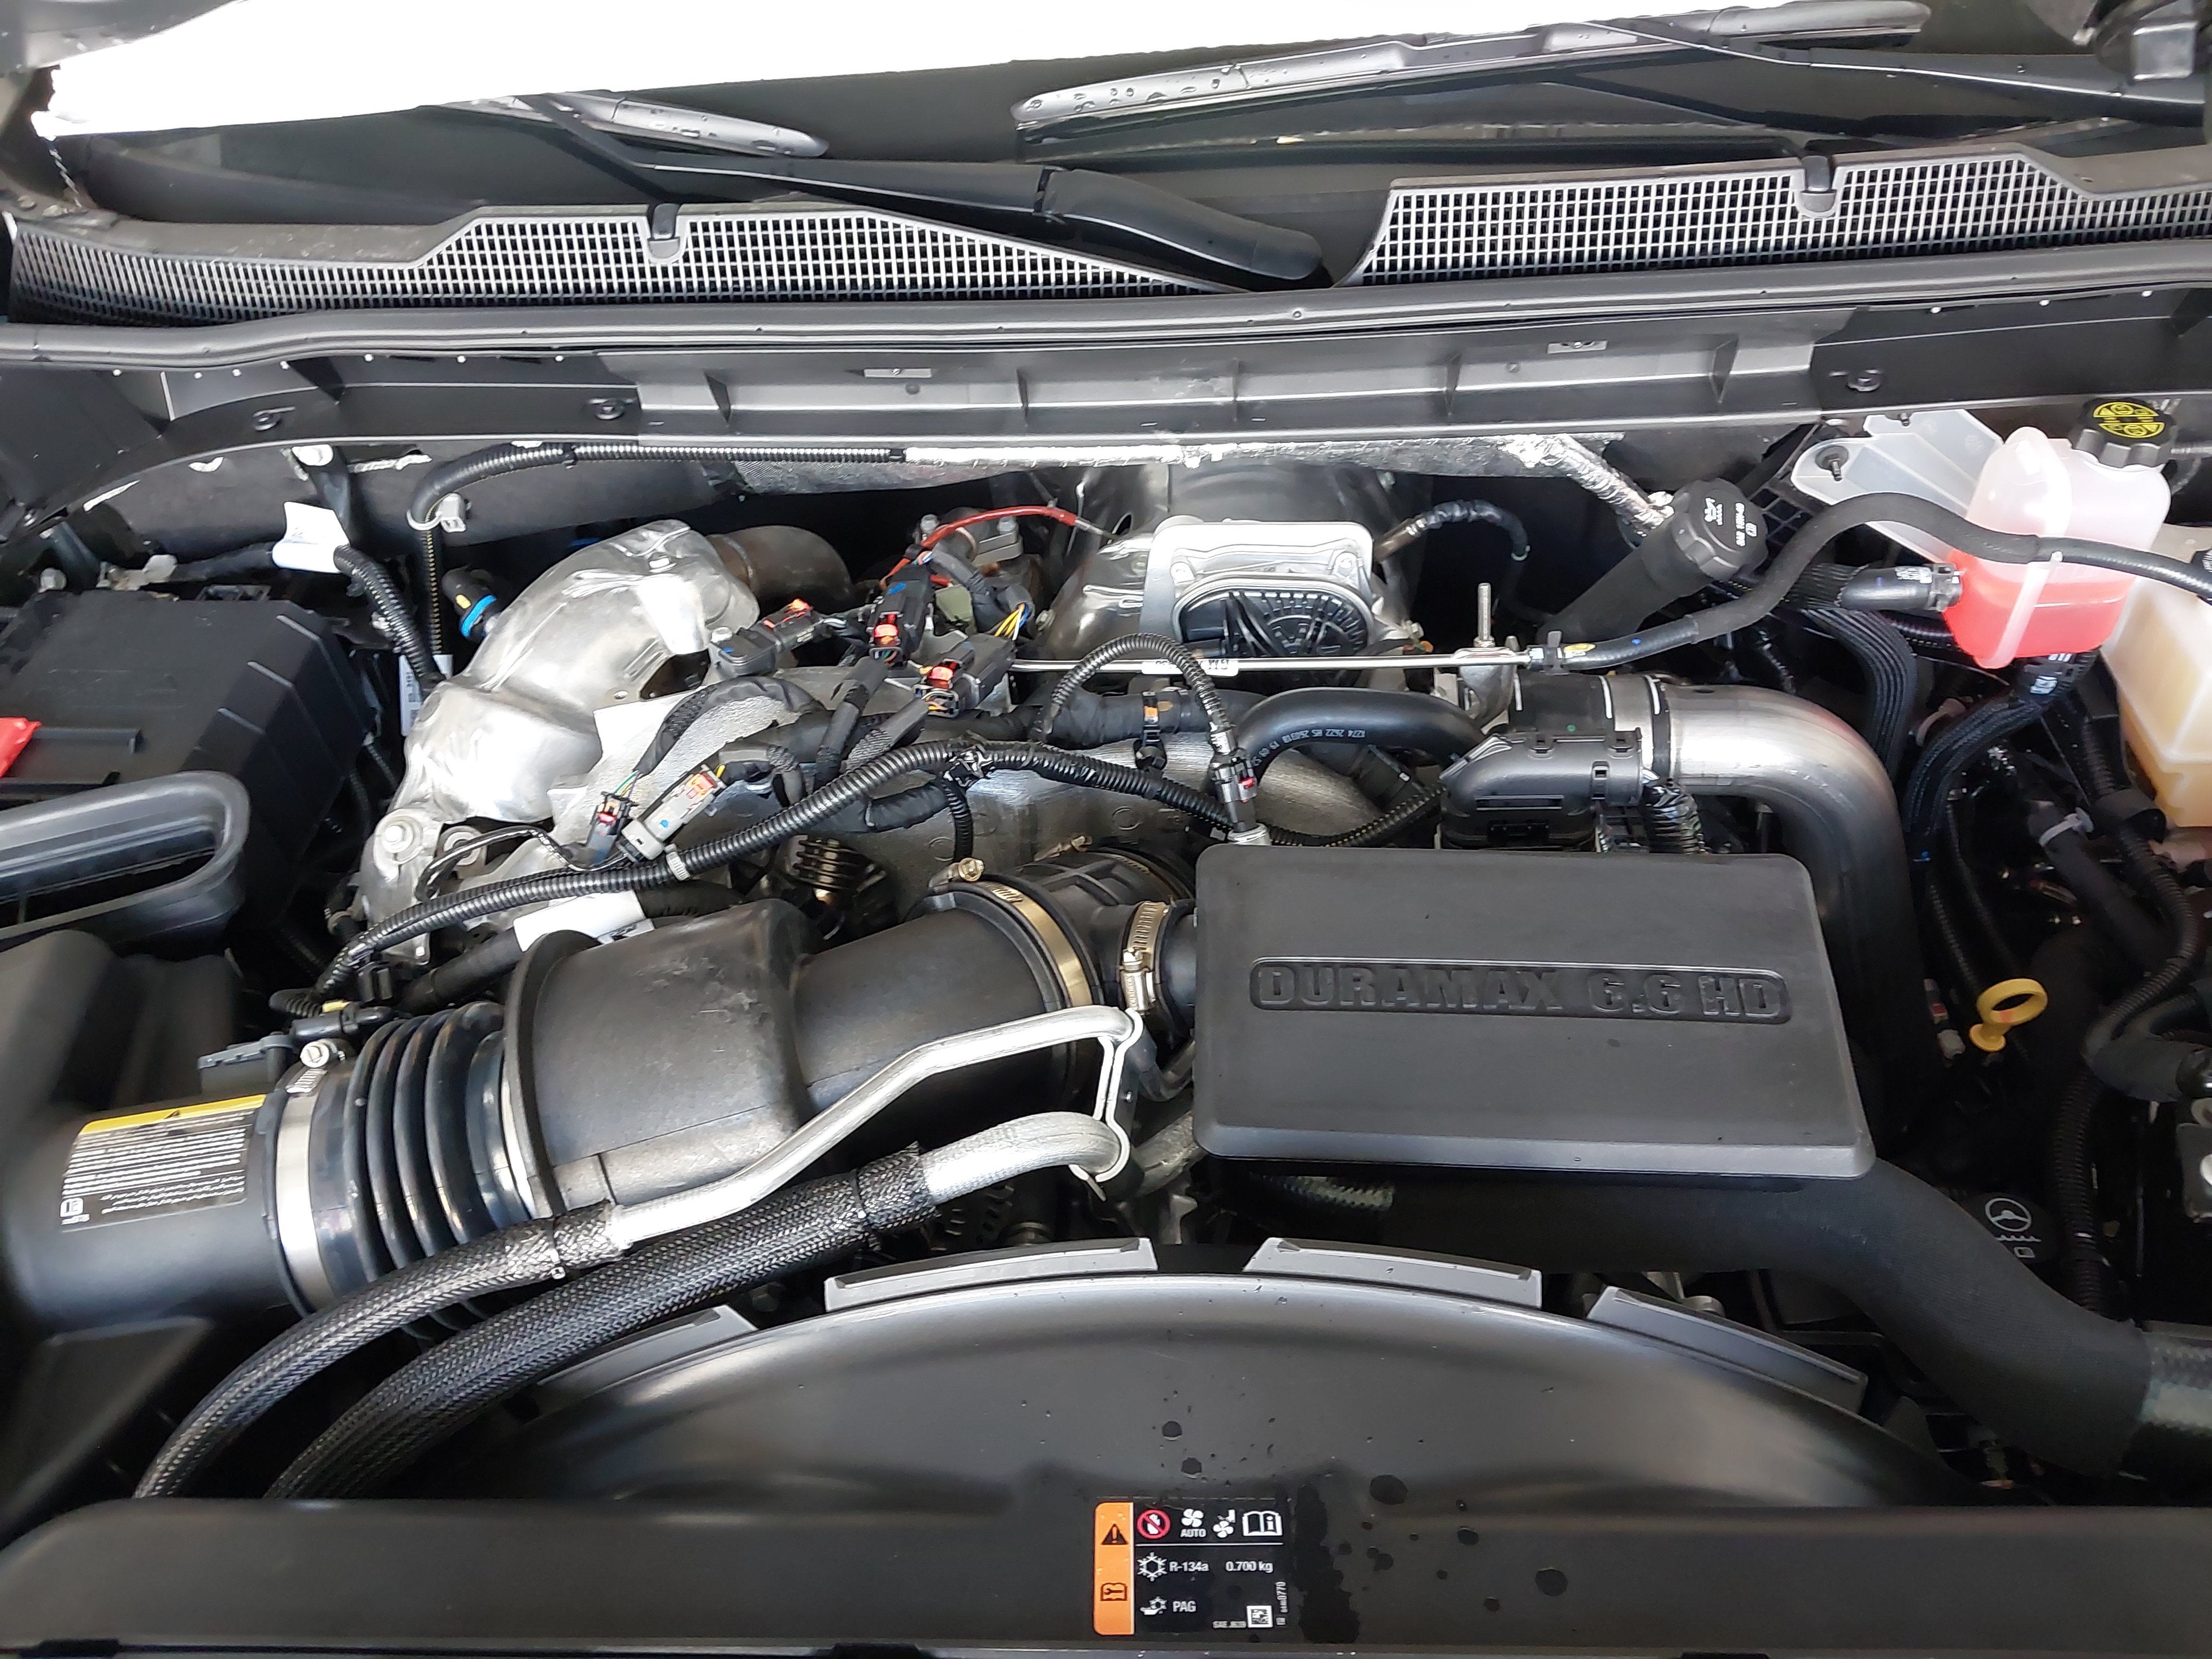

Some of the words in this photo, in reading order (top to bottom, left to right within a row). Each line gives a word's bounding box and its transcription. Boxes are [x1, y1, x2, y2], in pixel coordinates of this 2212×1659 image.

[1258, 966, 1563, 1010] DURAMAX
[1587, 973, 1682, 1014] 6.6
[1699, 975, 1780, 1018] HD
[1180, 1528, 1206, 1538] AUTO
[1169, 1561, 1210, 1572] R-134a
[1258, 1561, 1274, 1573] kg
[1172, 1601, 1197, 1612] PAG
